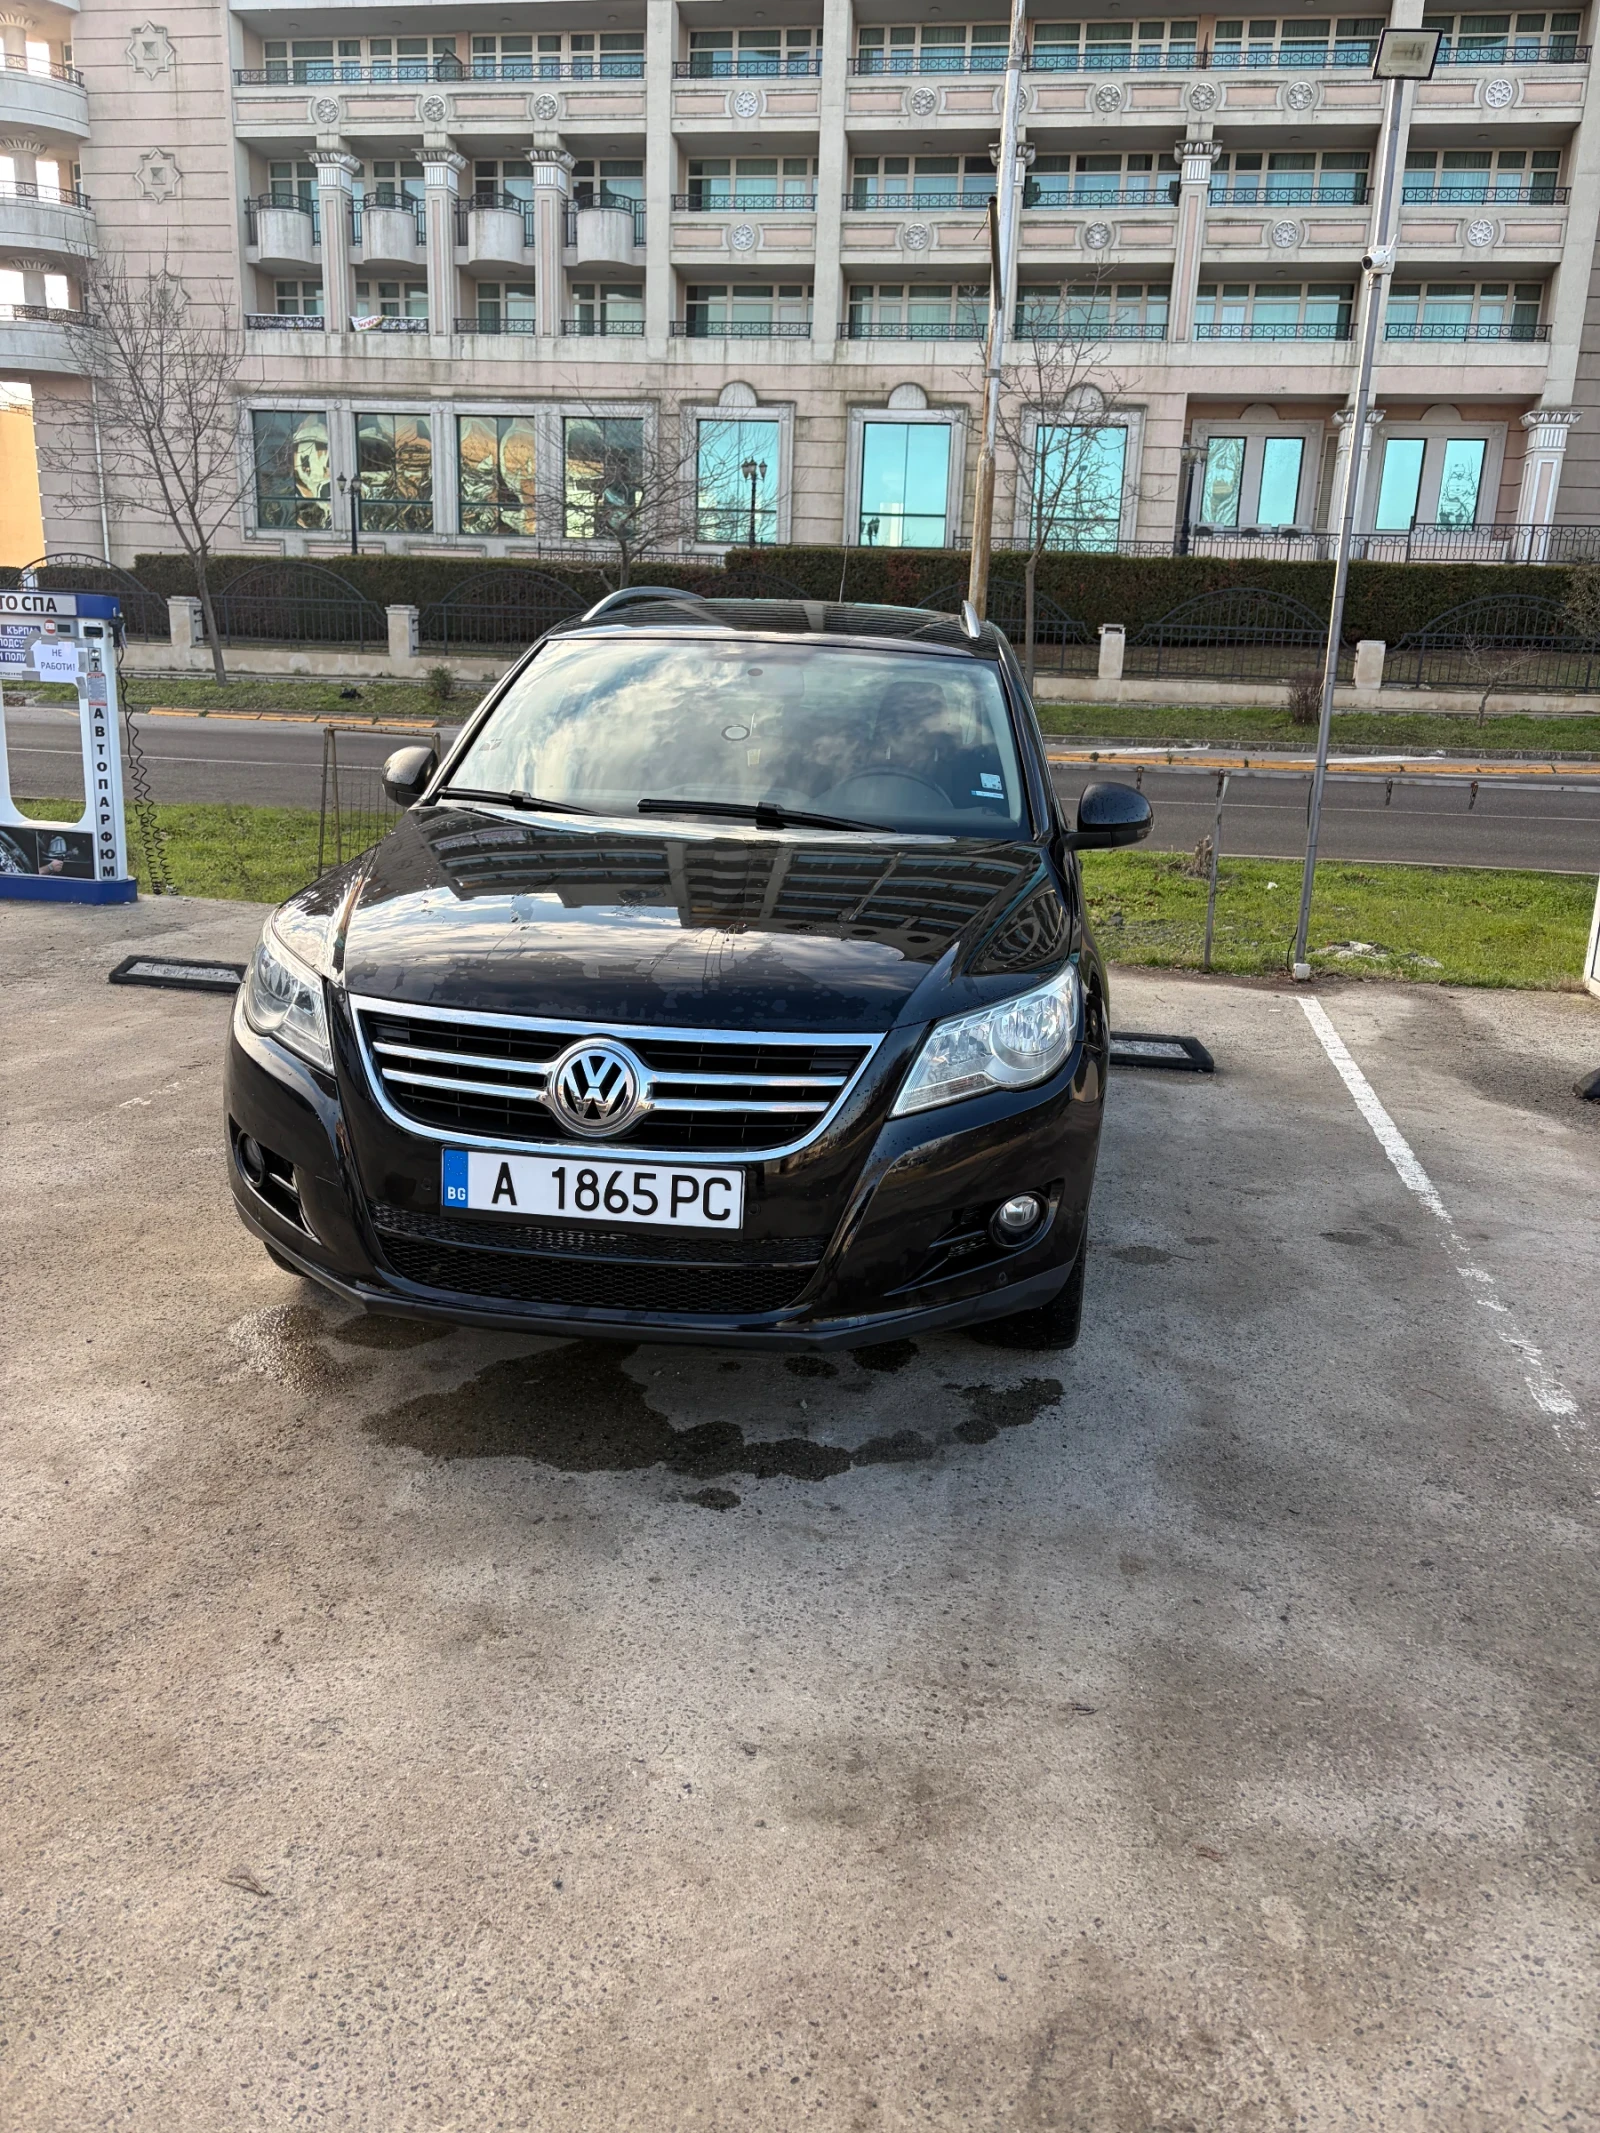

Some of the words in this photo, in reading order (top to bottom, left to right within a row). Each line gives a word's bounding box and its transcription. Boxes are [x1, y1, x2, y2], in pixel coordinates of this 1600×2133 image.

[21, 596, 58, 612] СПА
[51, 648, 62, 657] НЕ
[40, 661, 76, 671] РАБОТИ!
[93, 707, 116, 877] АВТОПАРФЮМ
[490, 1161, 519, 1206] A
[447, 1186, 467, 1201] BG
